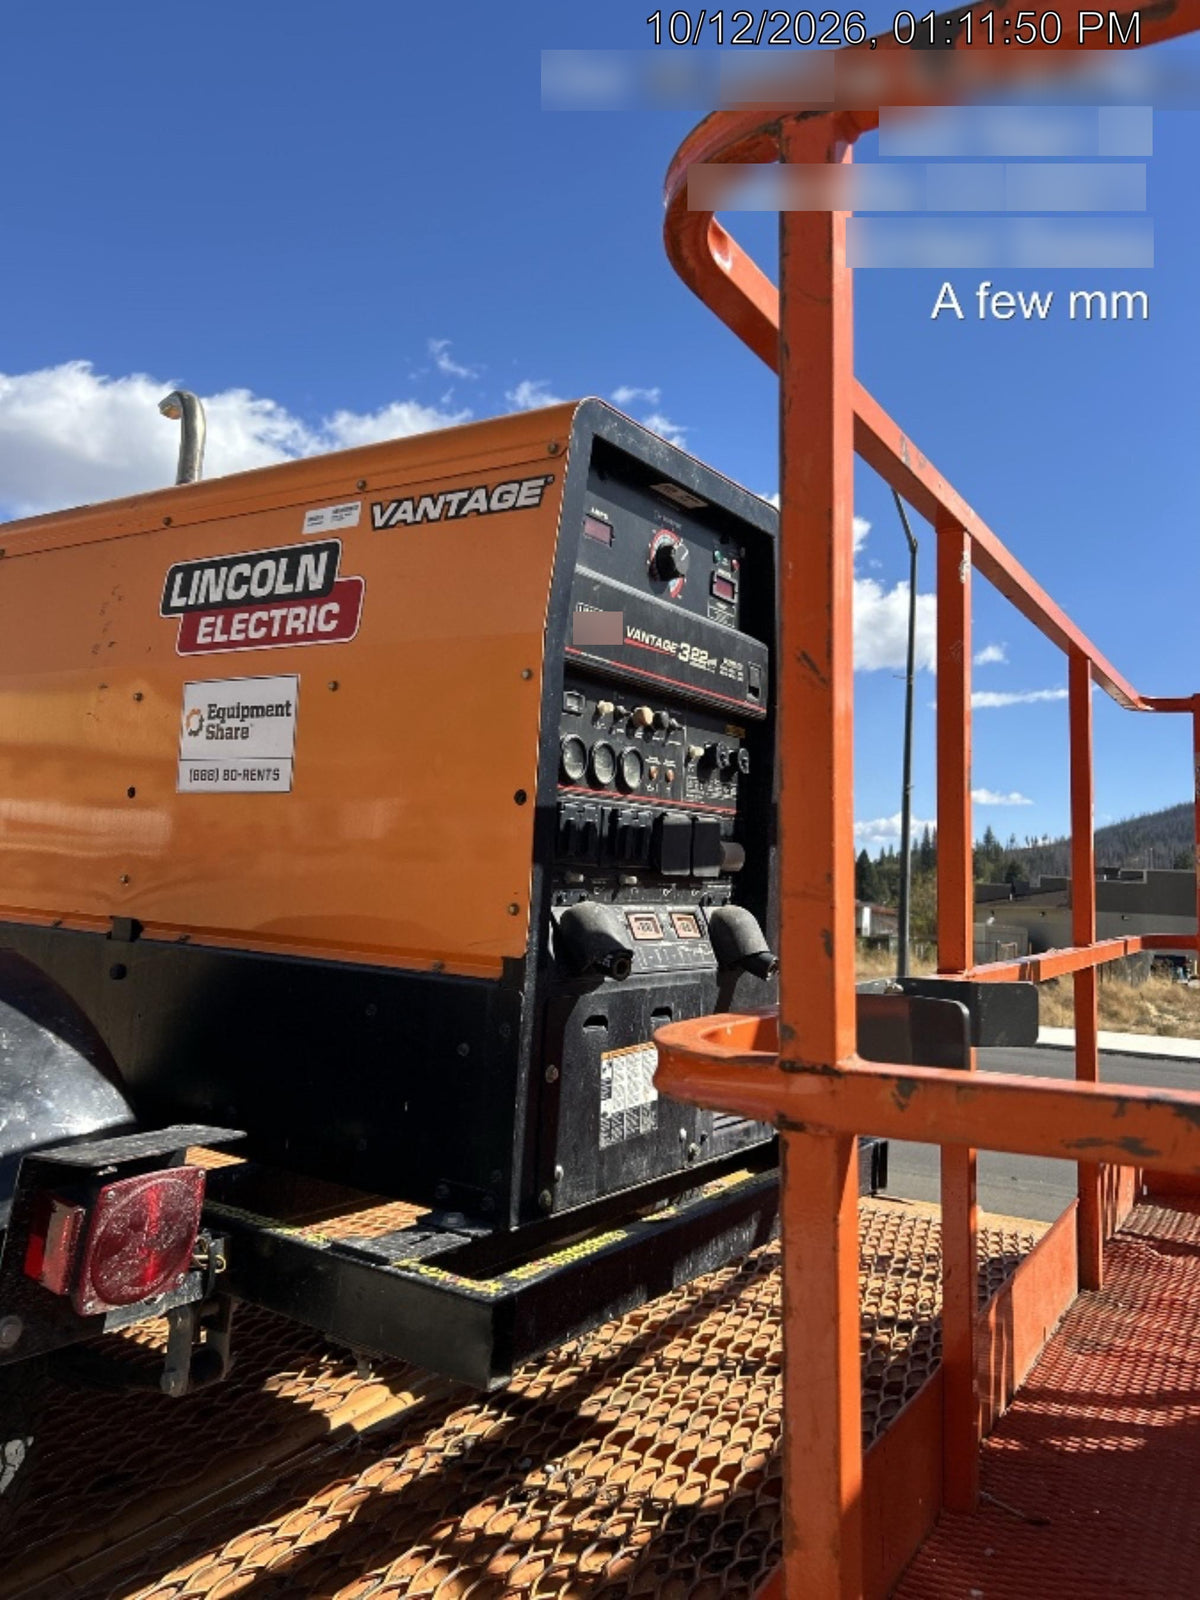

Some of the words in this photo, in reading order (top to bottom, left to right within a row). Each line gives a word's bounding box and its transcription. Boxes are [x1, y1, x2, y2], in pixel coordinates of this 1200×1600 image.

[372, 477, 546, 528] VANTAGE
[169, 550, 330, 607] LINCOLN
[196, 602, 340, 644] ELECTRIC
[626, 625, 680, 654] VANTAGE
[207, 700, 292, 723] Equipment
[205, 724, 250, 740] Share
